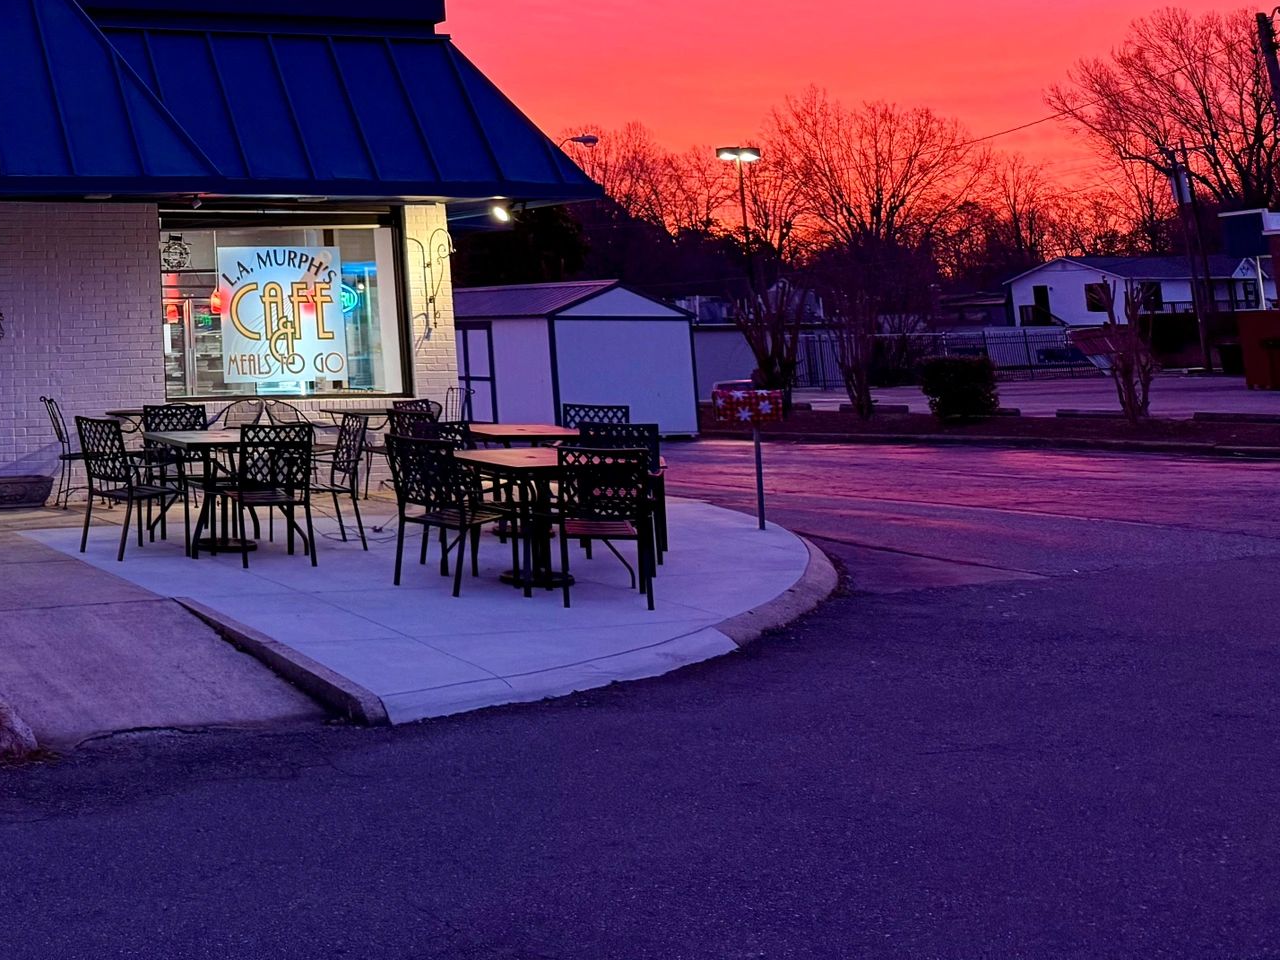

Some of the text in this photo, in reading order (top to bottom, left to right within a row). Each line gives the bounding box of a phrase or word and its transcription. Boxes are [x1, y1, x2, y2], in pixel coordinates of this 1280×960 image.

[221, 249, 337, 287] L.A. MURPH'S
[230, 281, 335, 341] CAFE
[227, 352, 345, 376] MEALS TO GO
